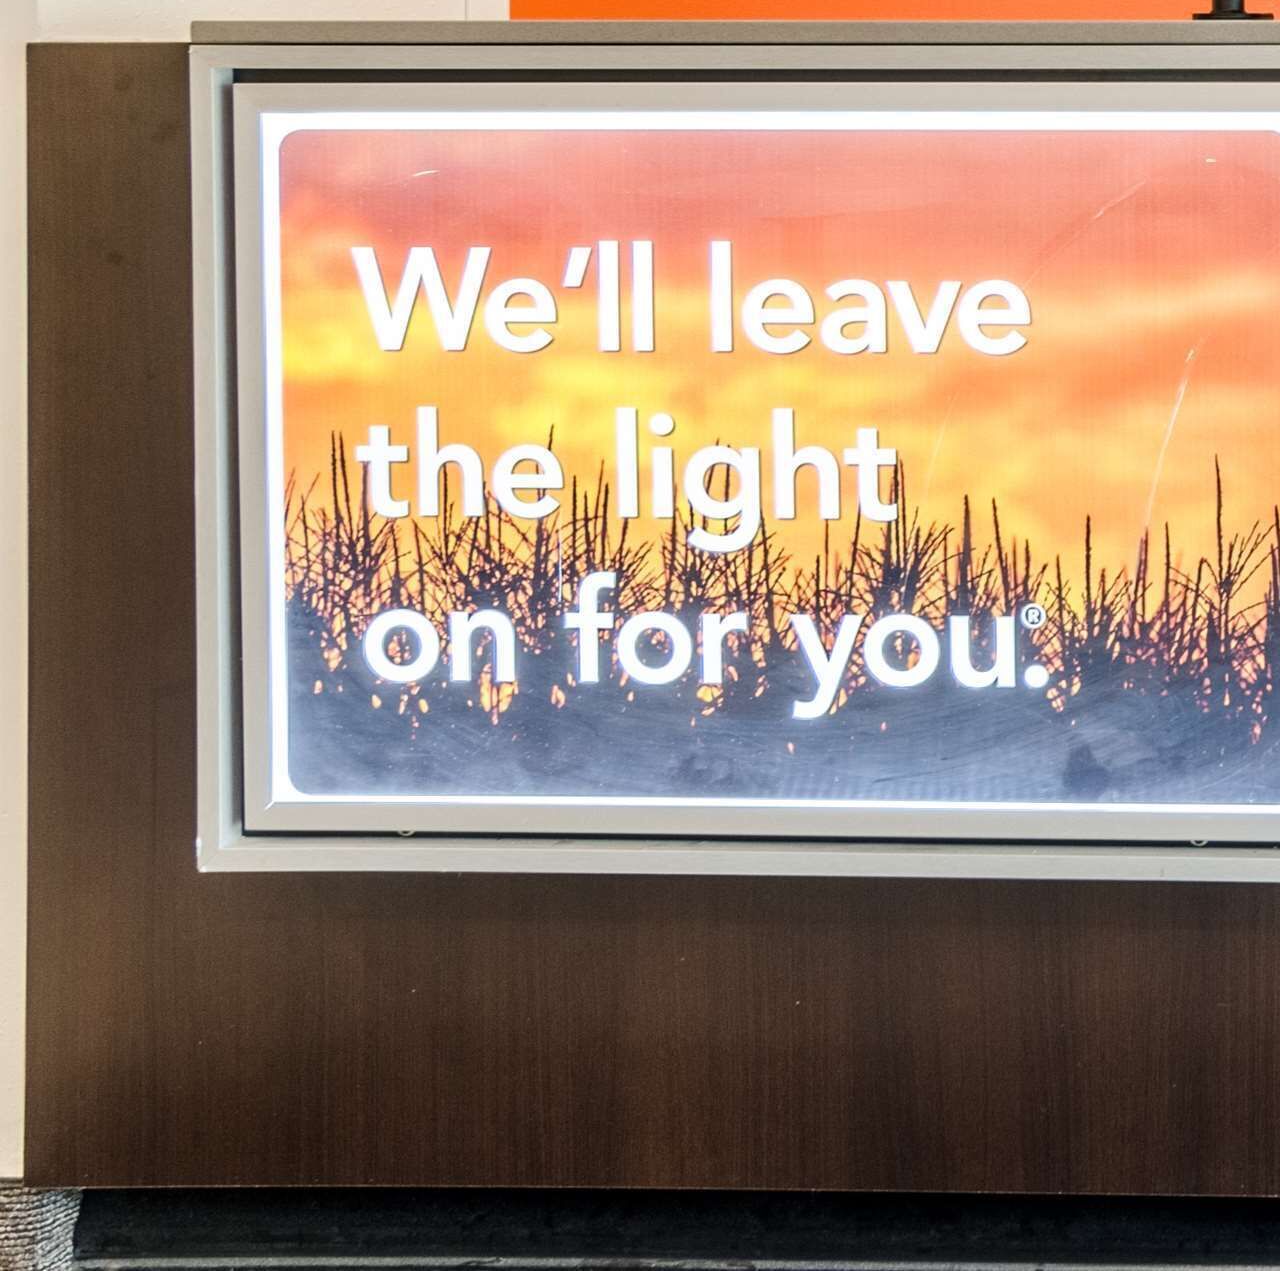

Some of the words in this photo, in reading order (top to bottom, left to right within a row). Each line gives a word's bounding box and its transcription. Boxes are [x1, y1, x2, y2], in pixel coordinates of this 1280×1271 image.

[350, 240, 654, 353] We'll
[710, 240, 1032, 356] leave
[355, 406, 564, 519] the
[615, 406, 899, 553] light
[363, 608, 517, 684] on
[563, 571, 749, 686] for
